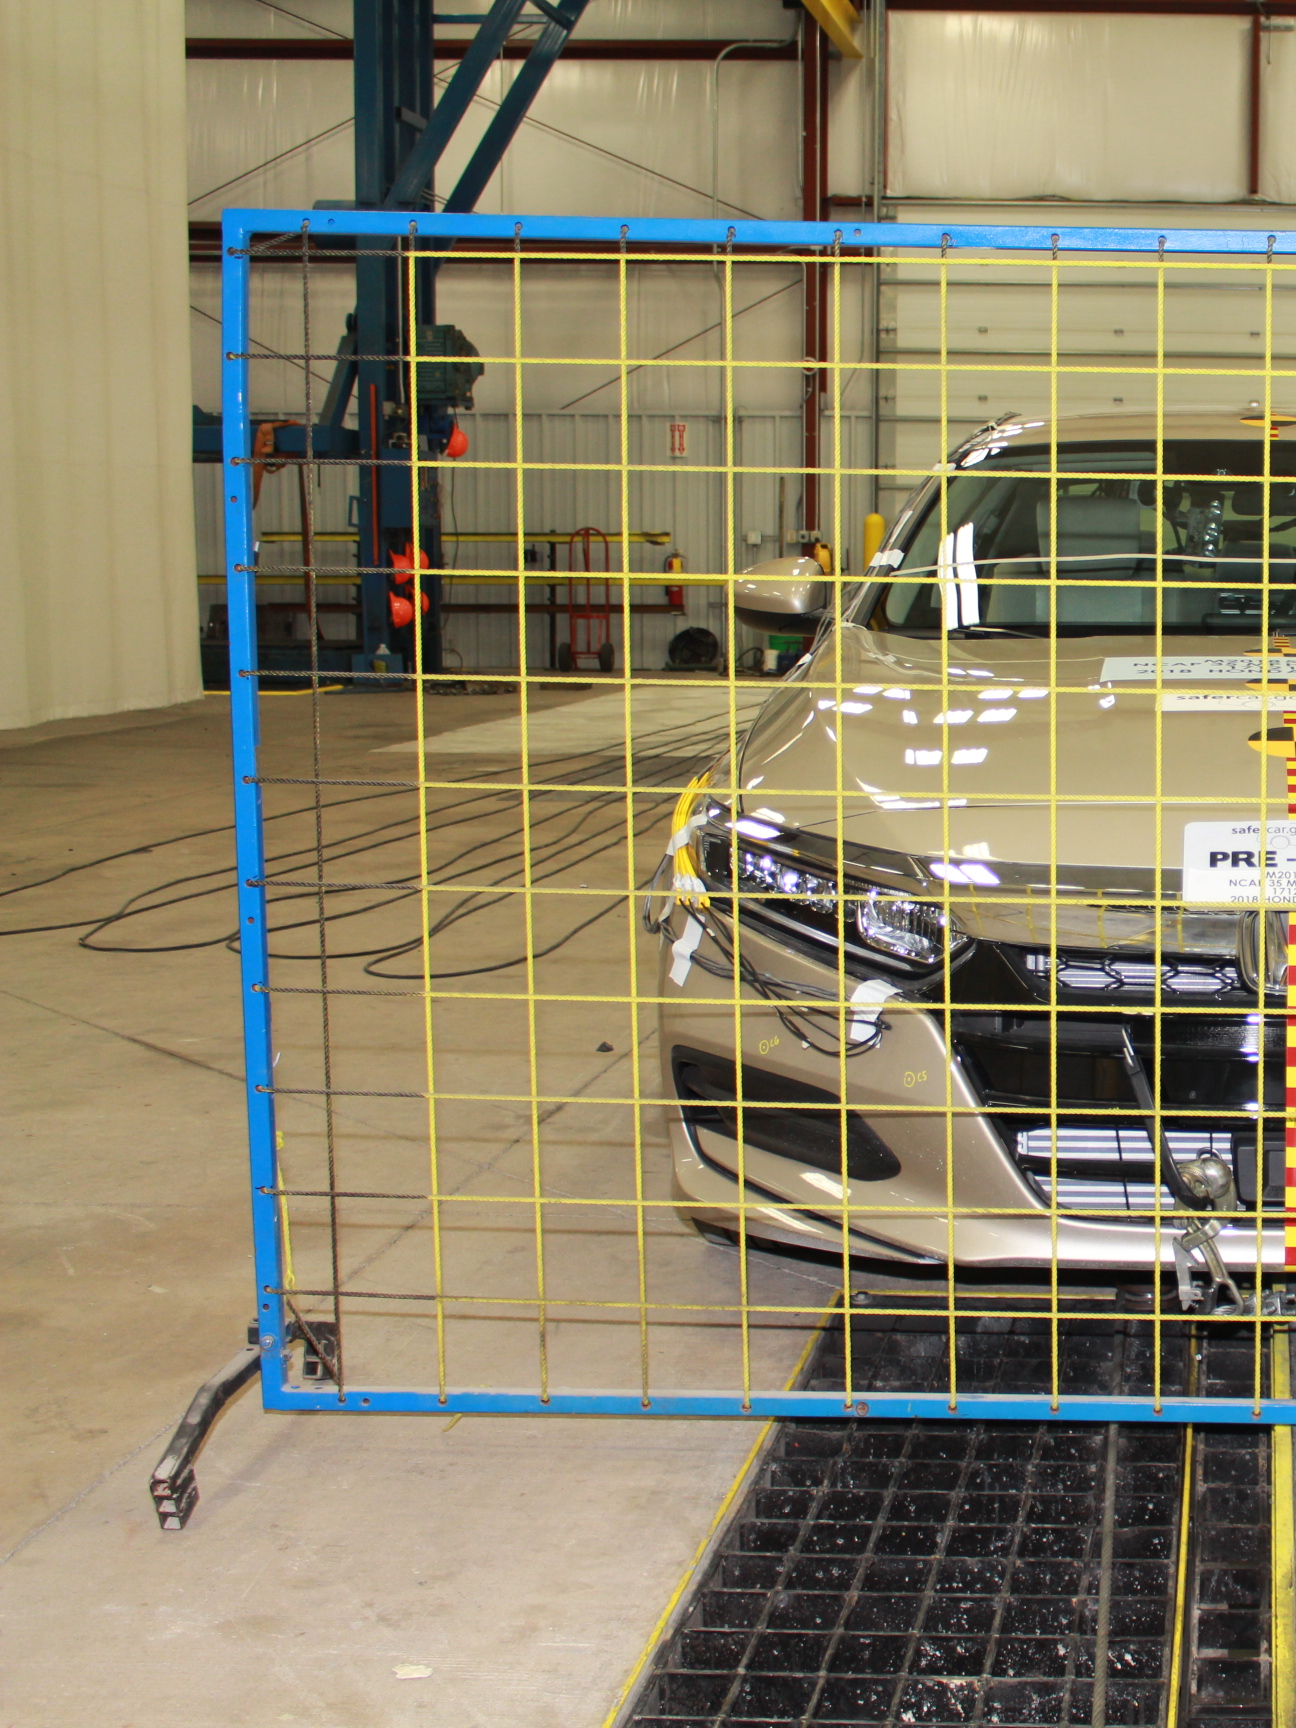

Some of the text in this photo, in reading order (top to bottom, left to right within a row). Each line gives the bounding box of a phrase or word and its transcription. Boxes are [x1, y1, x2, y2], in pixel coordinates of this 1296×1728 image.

[1209, 850, 1278, 868] PRE
[1268, 879, 1282, 888] 35
[1230, 895, 1259, 903] 2018
